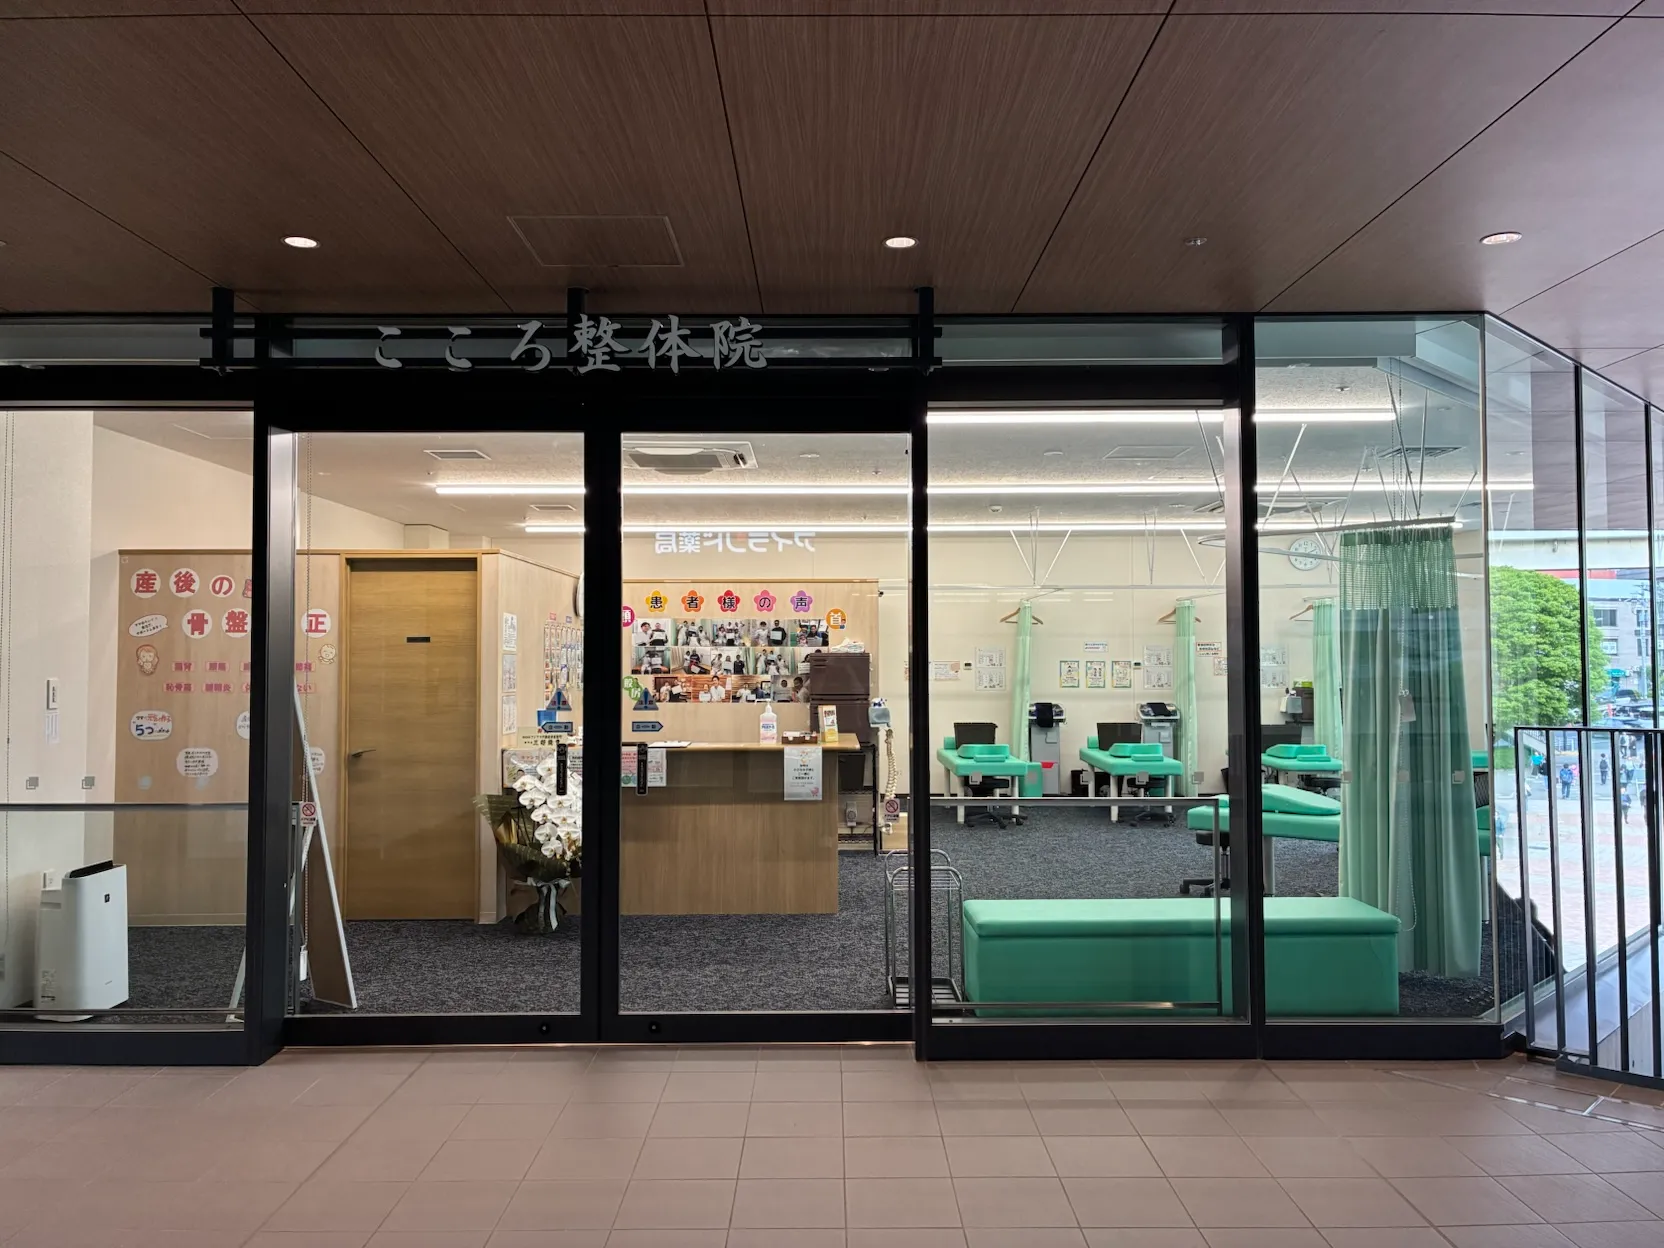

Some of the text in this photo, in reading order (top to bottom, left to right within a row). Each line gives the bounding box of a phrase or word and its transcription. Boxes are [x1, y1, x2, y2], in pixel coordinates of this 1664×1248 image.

[375, 313, 768, 374] こころ整体院
[134, 571, 233, 595] 産後の
[650, 596, 808, 609] 患者様の声
